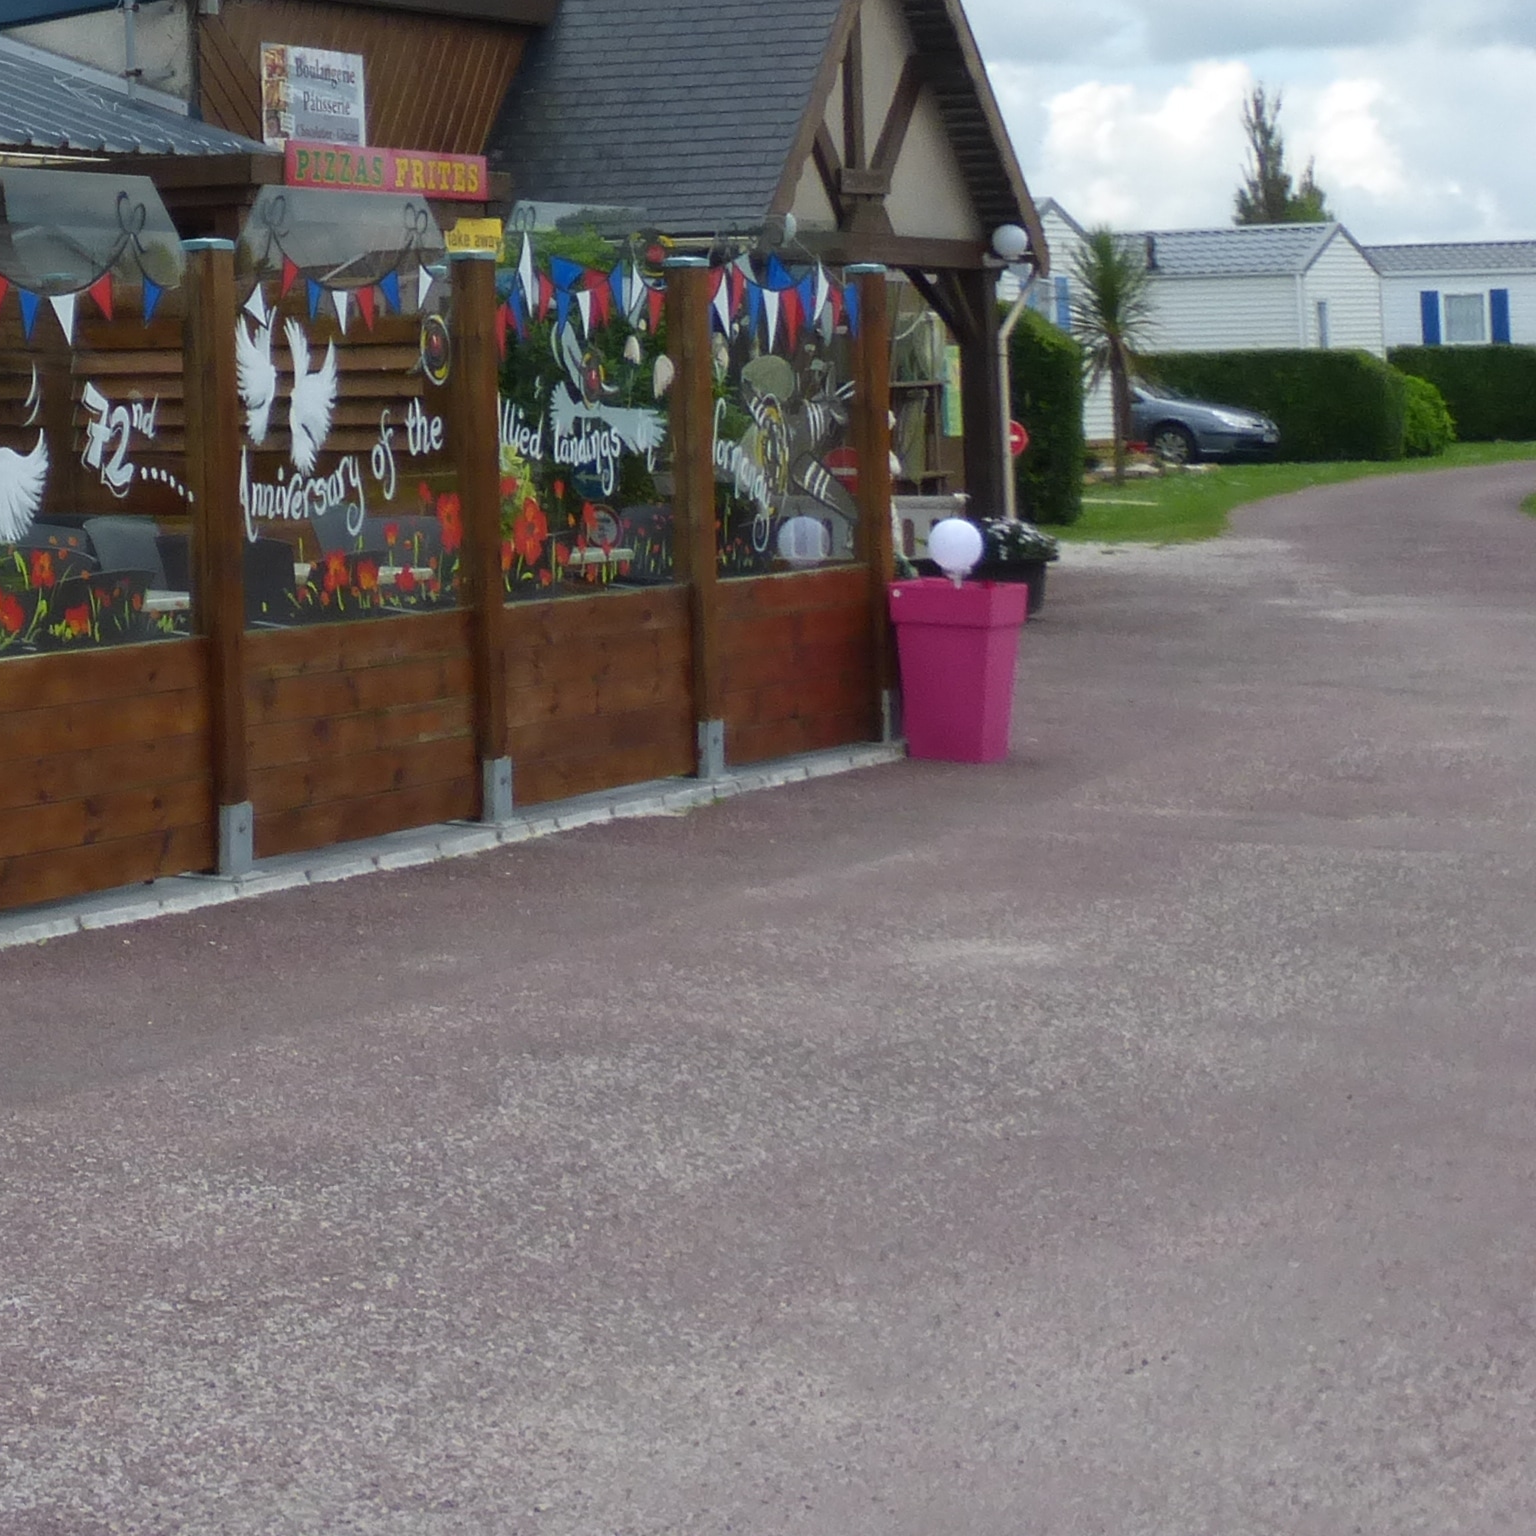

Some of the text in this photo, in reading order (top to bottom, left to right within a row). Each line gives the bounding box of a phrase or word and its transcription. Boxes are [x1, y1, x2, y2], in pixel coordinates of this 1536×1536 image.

[294, 56, 356, 89] Boulangerie
[302, 90, 351, 116] Pâtisserie
[294, 148, 479, 193] PIZZAS FRITES
[371, 409, 396, 501] of
[404, 396, 445, 457] the
[554, 414, 622, 497] landings
